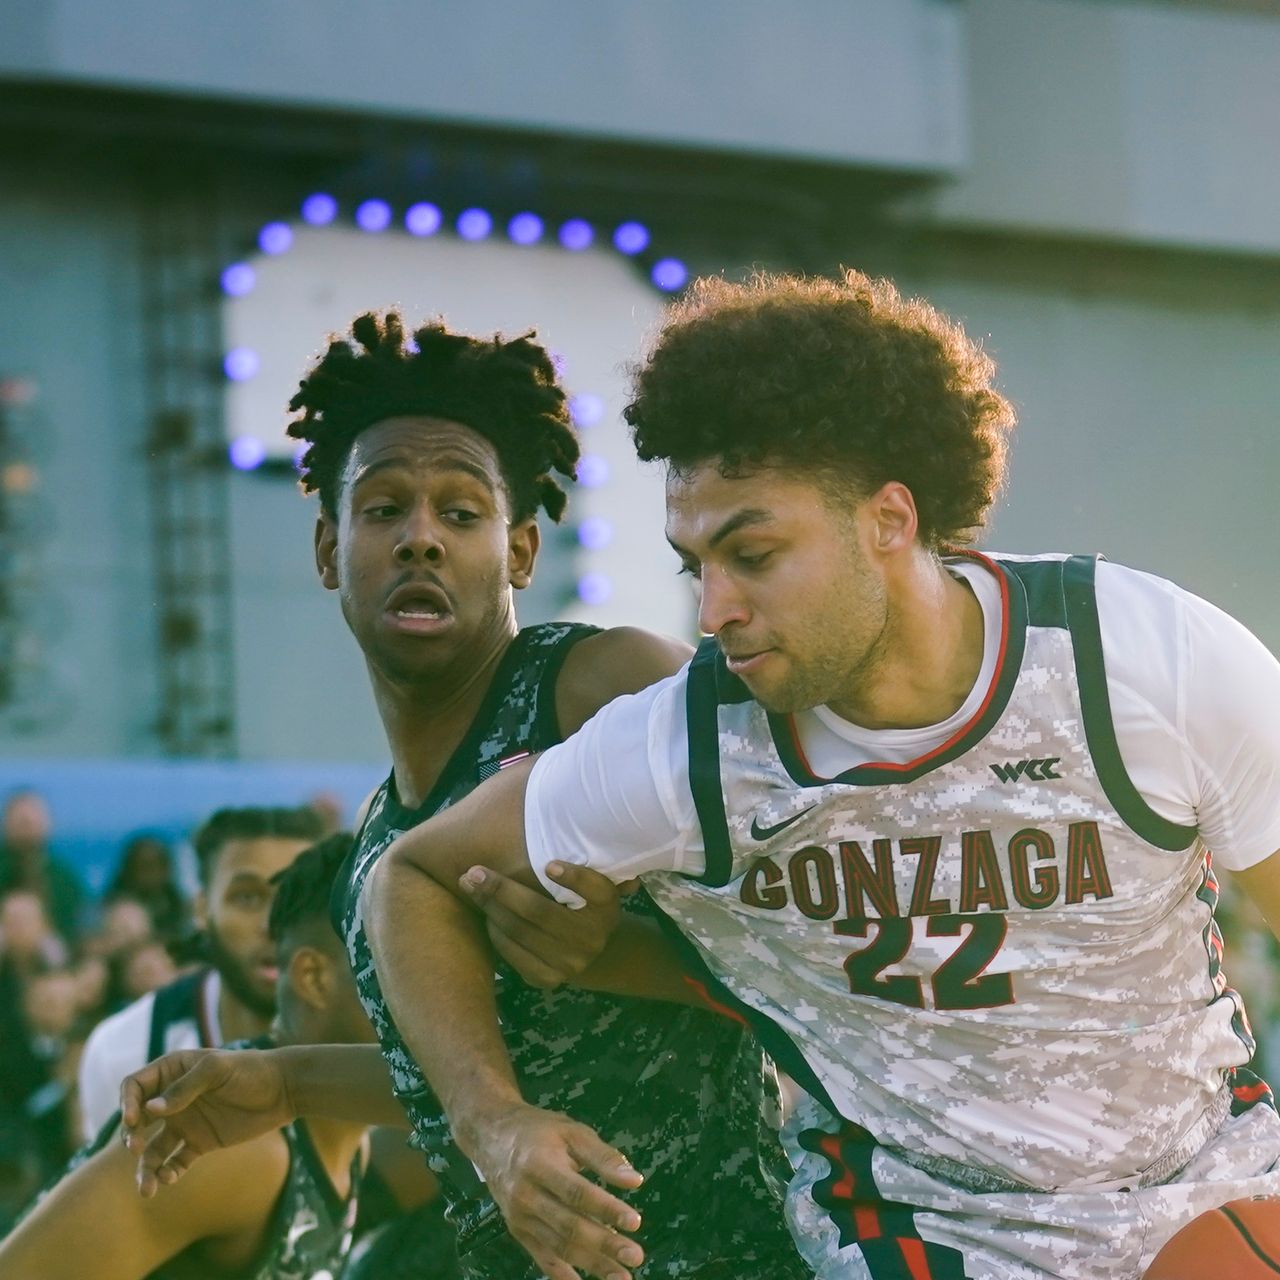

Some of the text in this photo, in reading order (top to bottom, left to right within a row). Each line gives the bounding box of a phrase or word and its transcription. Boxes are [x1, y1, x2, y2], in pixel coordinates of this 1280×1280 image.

[989, 757, 1063, 784] WCC
[739, 821, 1113, 921] GONZAGA
[833, 912, 1016, 1011] 22
